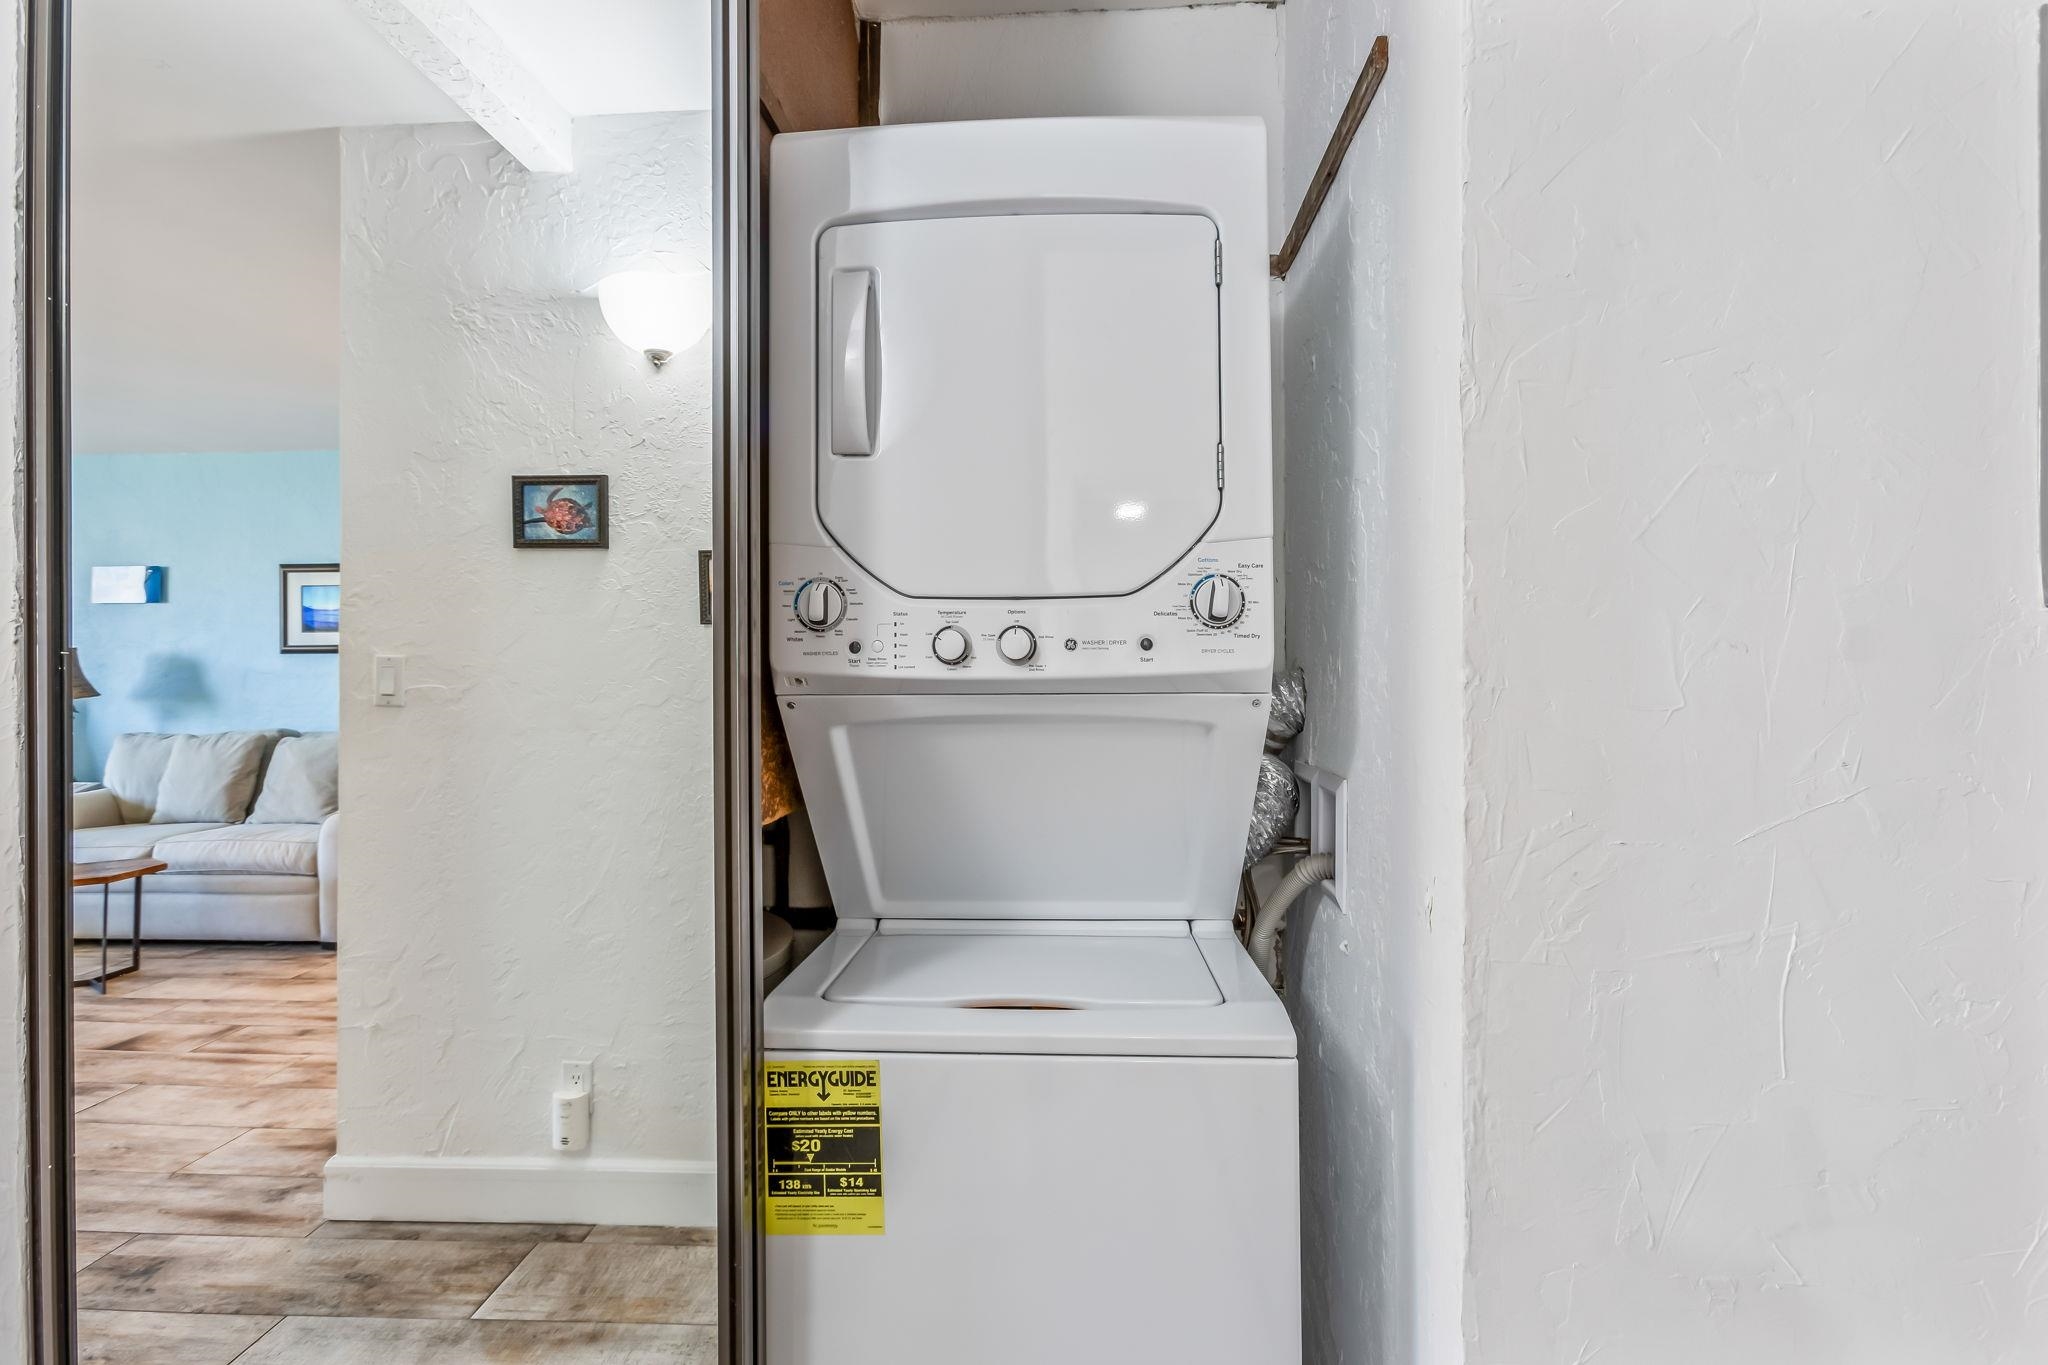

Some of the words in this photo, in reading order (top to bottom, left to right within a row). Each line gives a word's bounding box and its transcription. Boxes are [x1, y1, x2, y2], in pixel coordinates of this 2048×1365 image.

[766, 1070, 877, 1090] ENERGYGUIDE
[791, 1138, 821, 1152] $20
[778, 1179, 801, 1190] 138
[839, 1176, 864, 1188] $14
